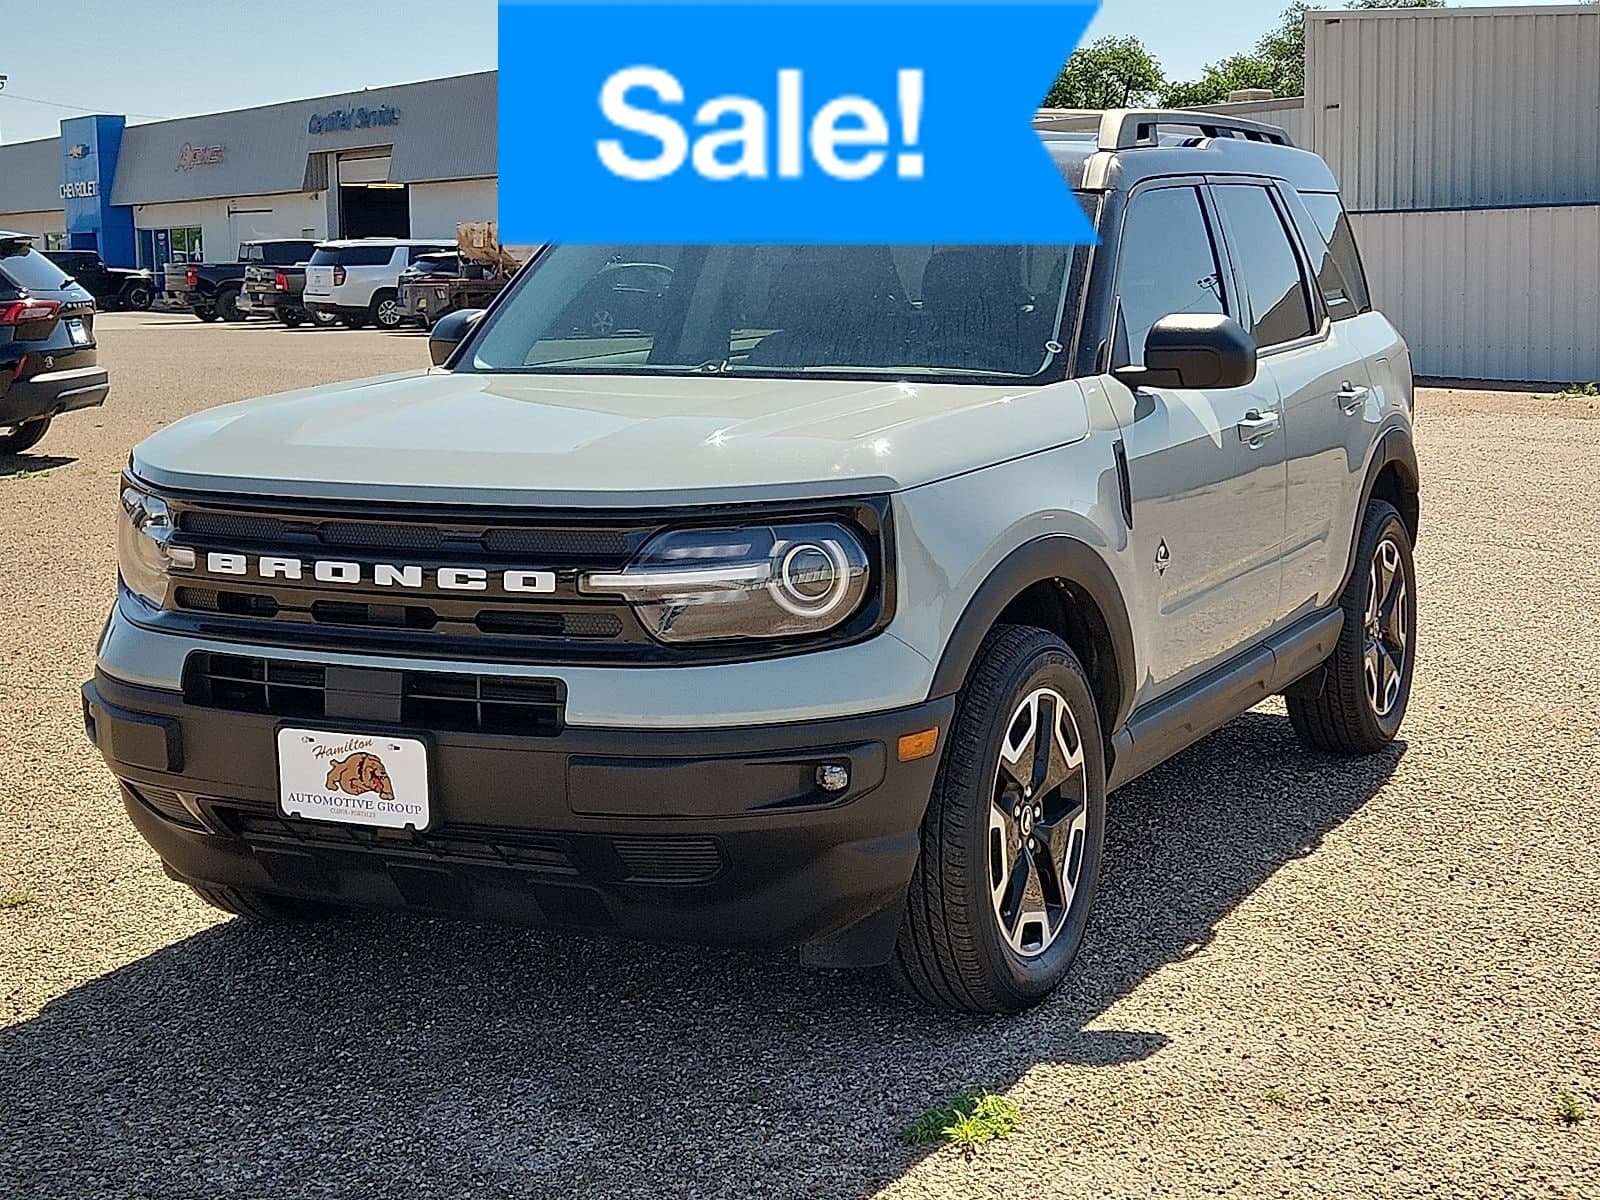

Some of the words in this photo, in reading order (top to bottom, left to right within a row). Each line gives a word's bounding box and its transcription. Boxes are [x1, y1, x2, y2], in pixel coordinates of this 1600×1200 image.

[60, 181, 96, 199] CHEVROLET
[207, 551, 556, 594] BRONCO
[312, 738, 374, 759] Hamilton
[288, 792, 374, 810] AUTOMOTIVE
[377, 802, 422, 815] GROUP
